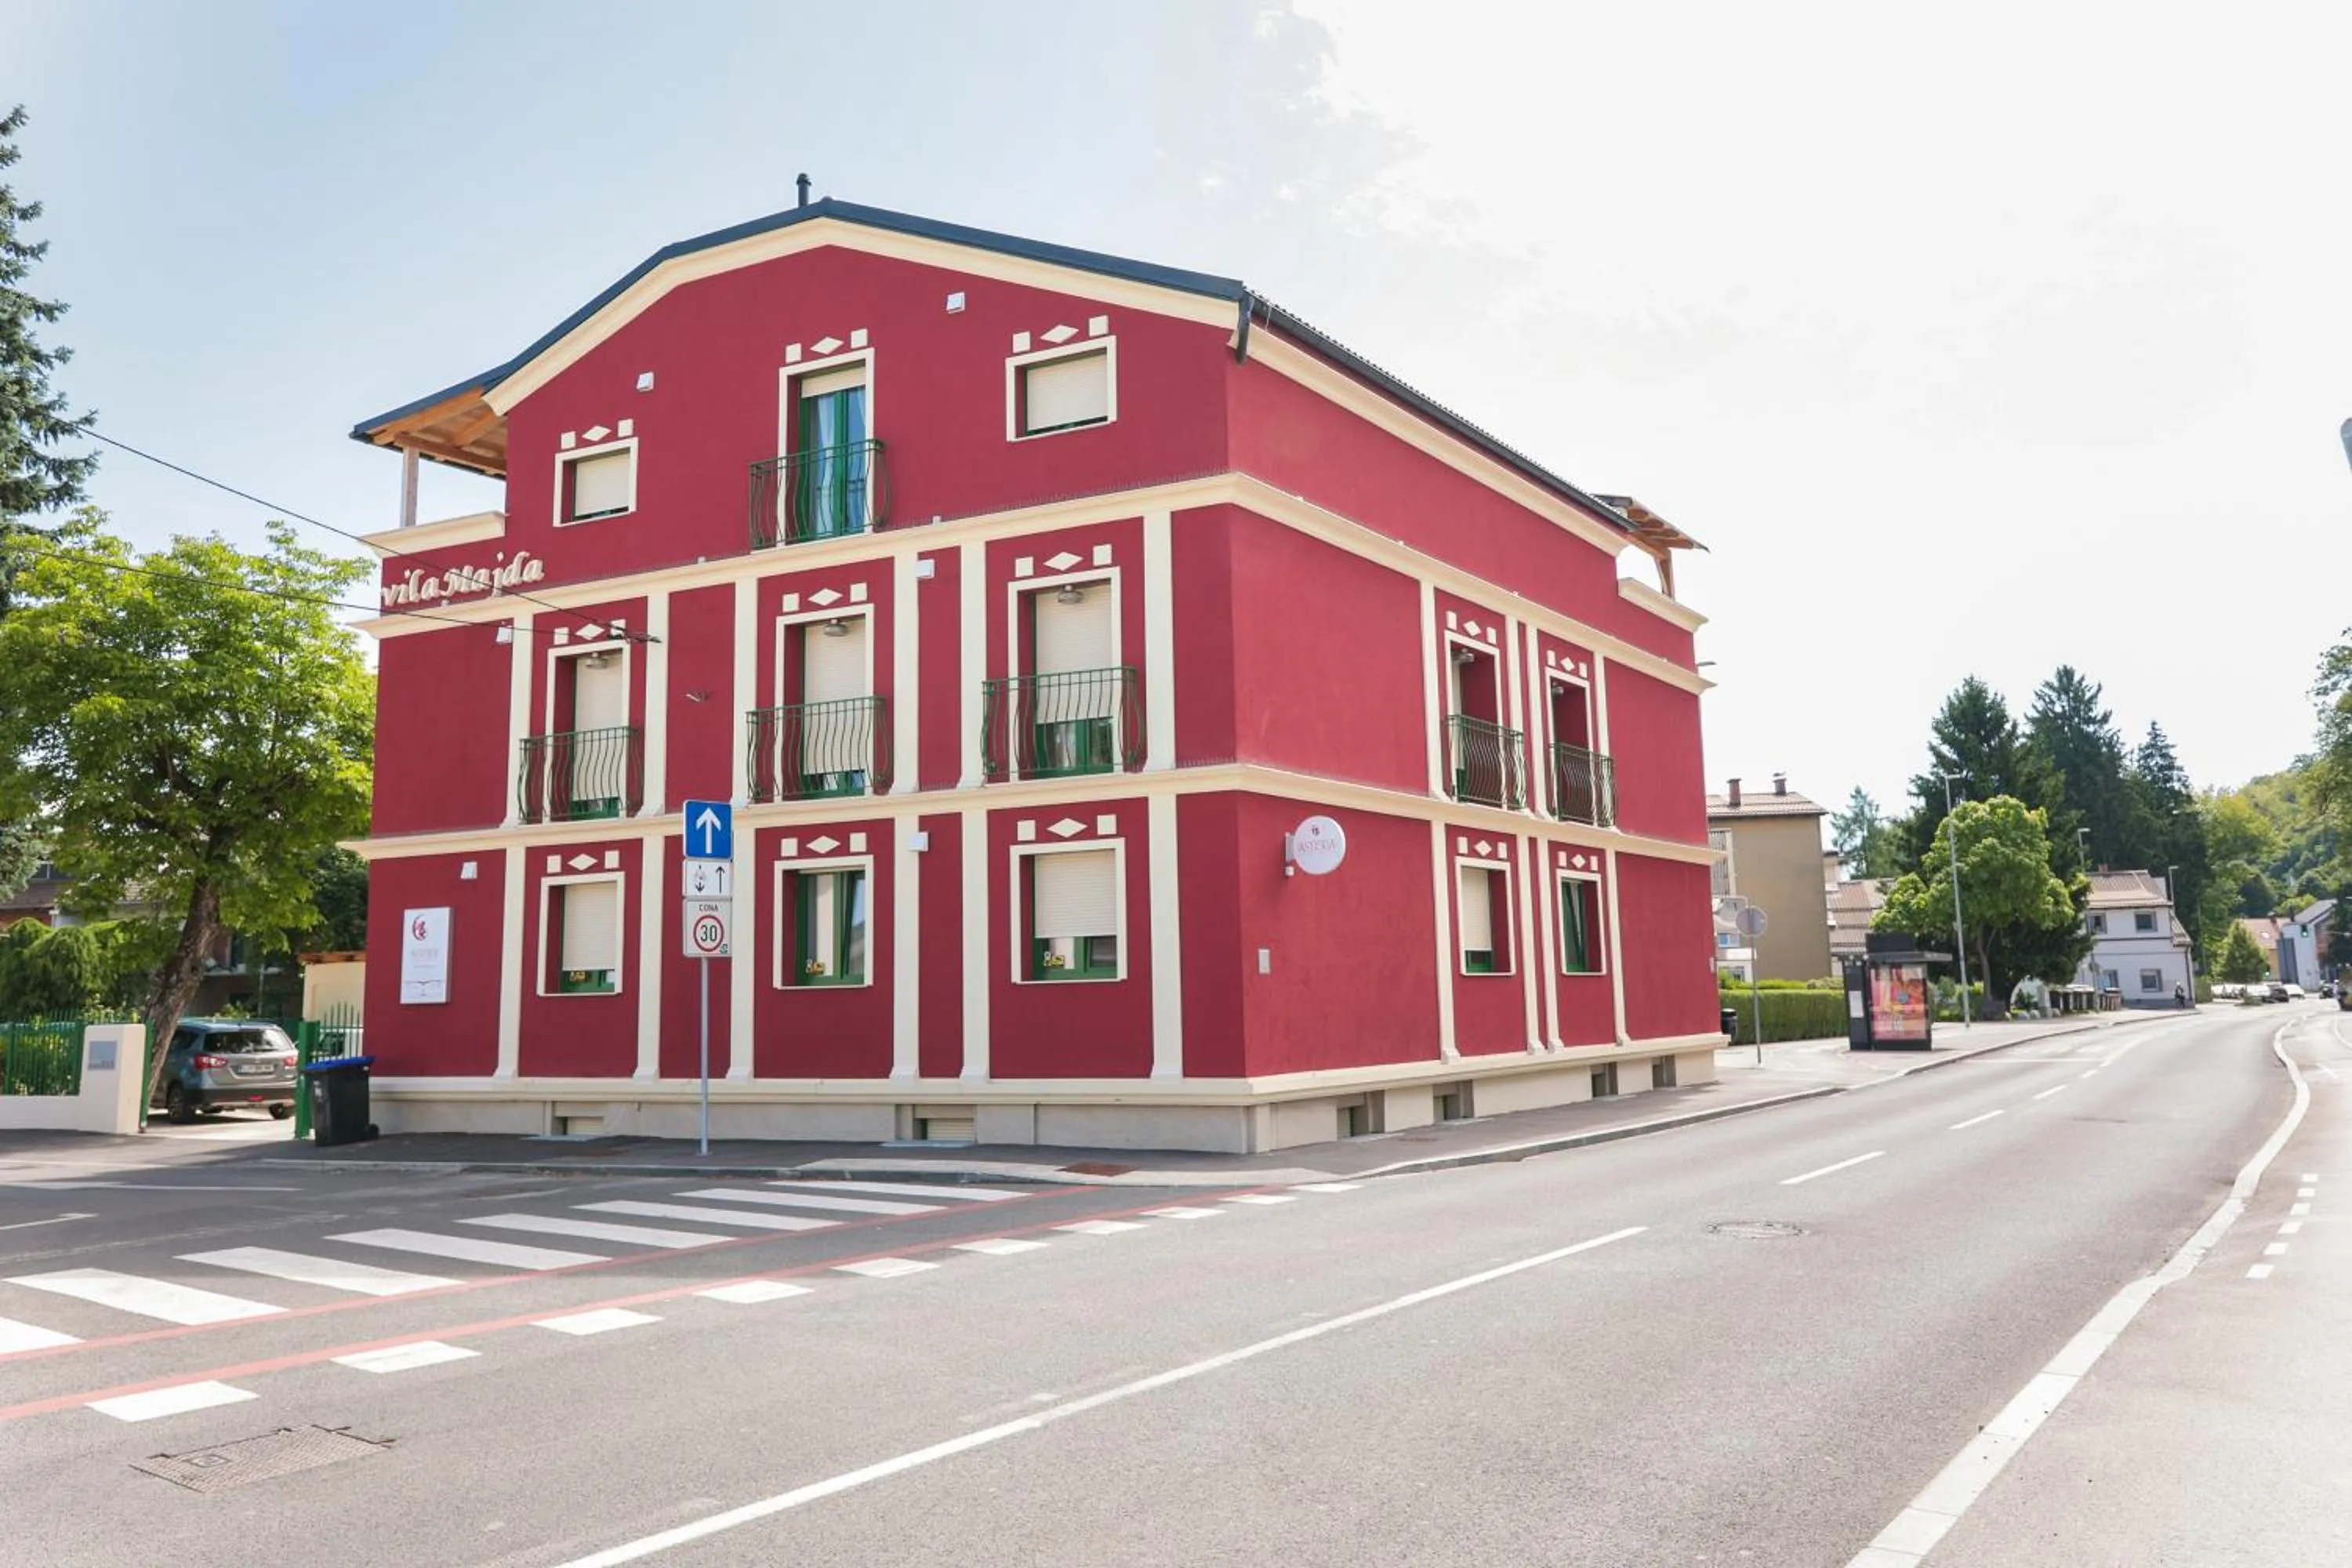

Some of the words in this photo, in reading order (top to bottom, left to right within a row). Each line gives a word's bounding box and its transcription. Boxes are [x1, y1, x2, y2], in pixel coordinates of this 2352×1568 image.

[381, 568, 440, 606] vila
[440, 551, 545, 597] Majda
[700, 924, 717, 942] 30
